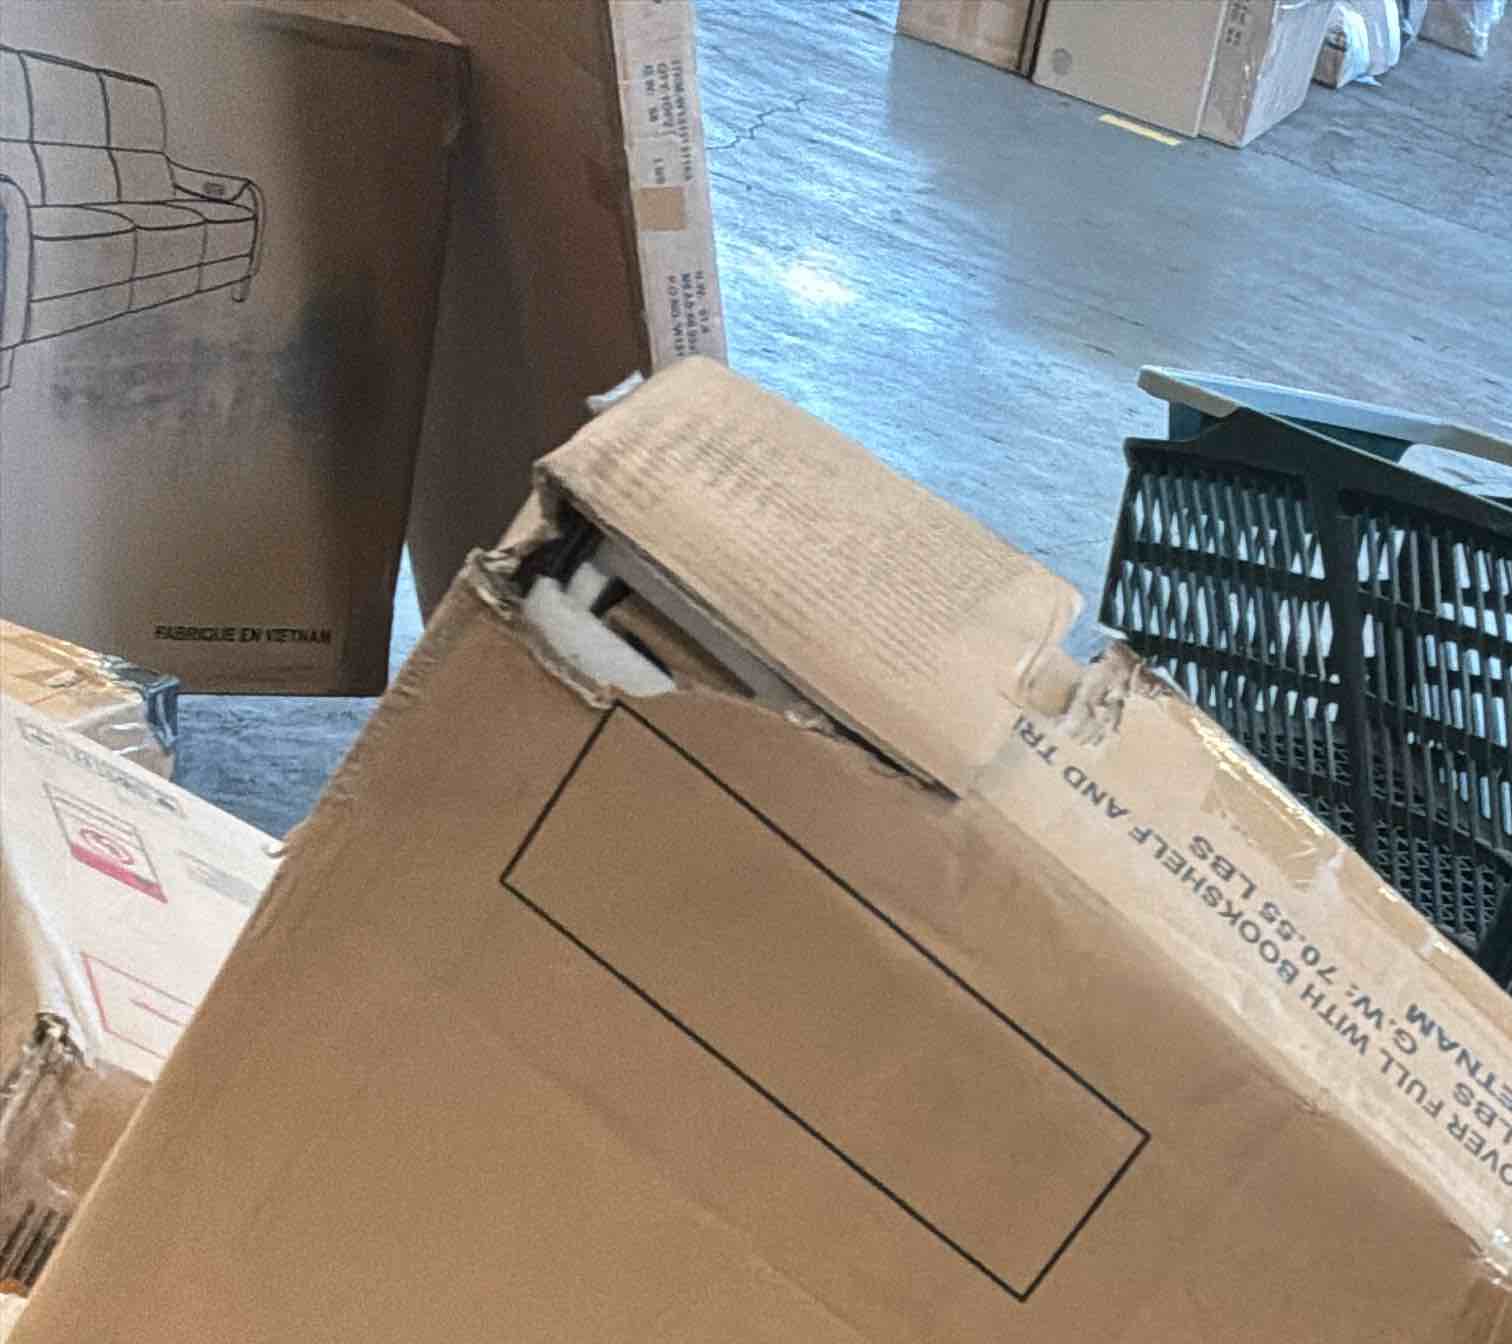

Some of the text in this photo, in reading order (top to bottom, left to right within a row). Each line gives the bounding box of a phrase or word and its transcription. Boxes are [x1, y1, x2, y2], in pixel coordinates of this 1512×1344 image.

[1063, 765, 1132, 819] AND
[1188, 835, 1259, 901] LBS
[1128, 825, 1301, 985] BOOKSHELF
[1259, 900, 1340, 986] 70.55
[1300, 983, 1371, 1056] WITH
[1347, 984, 1419, 1057] G.W:
[1380, 1048, 1445, 1119] FULL
